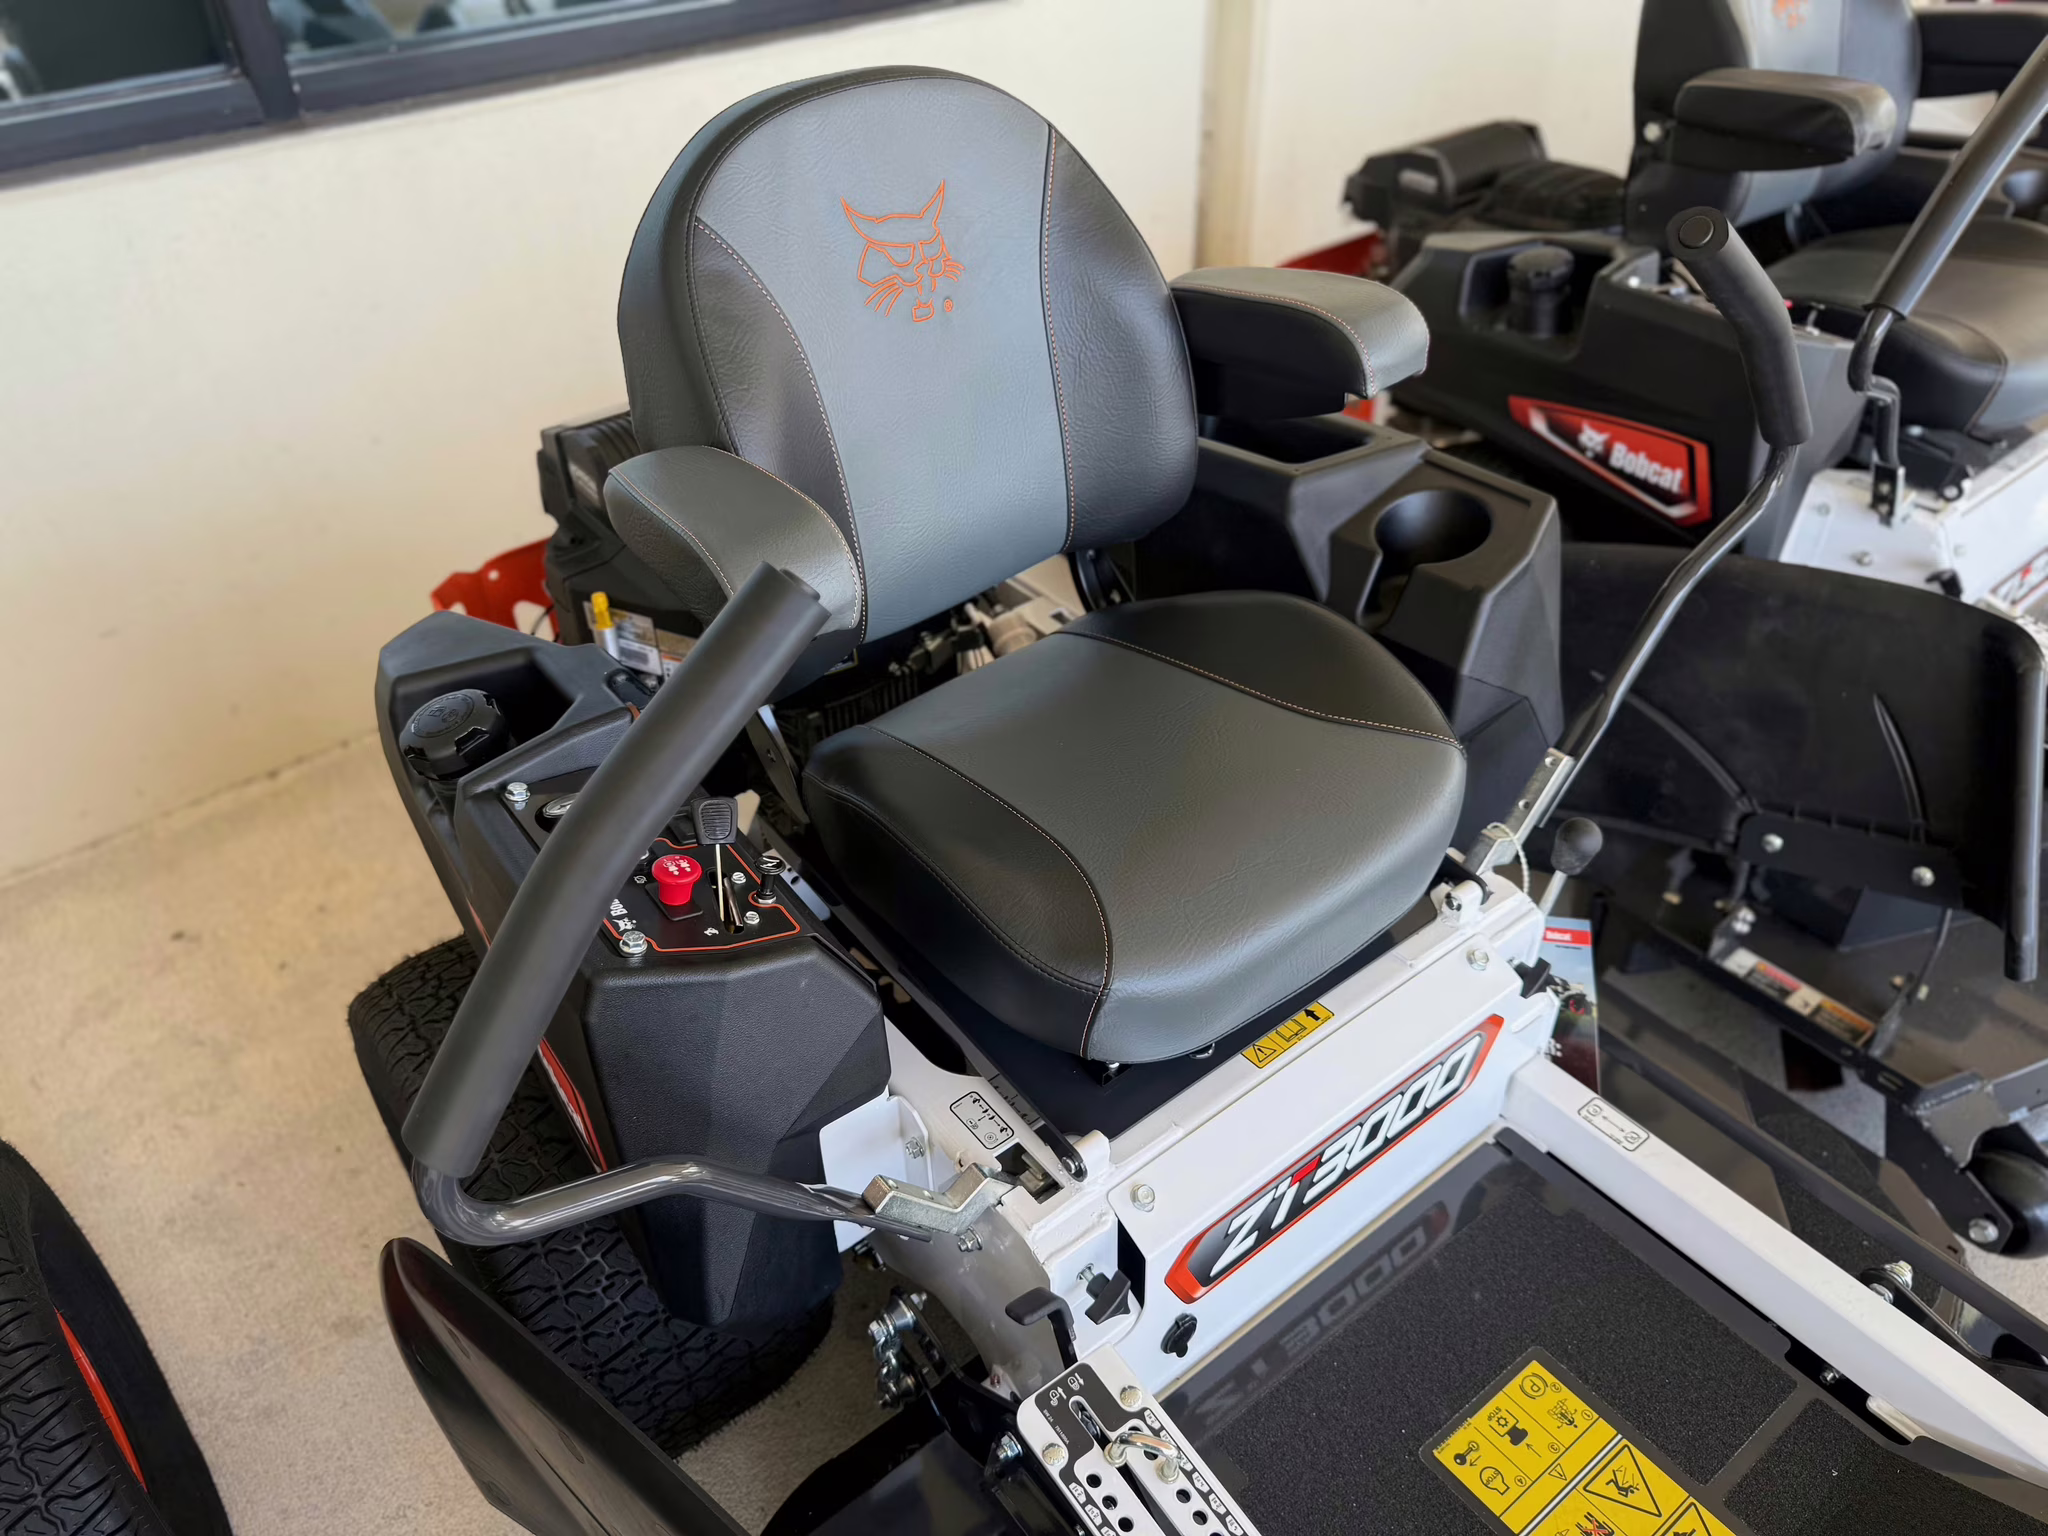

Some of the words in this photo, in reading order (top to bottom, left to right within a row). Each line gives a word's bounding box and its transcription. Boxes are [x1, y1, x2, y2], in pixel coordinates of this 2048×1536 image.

[1609, 442, 1684, 493] Bobcat
[1487, 1405, 1502, 1422] STOP
[1485, 1470, 1500, 1486] STOP
